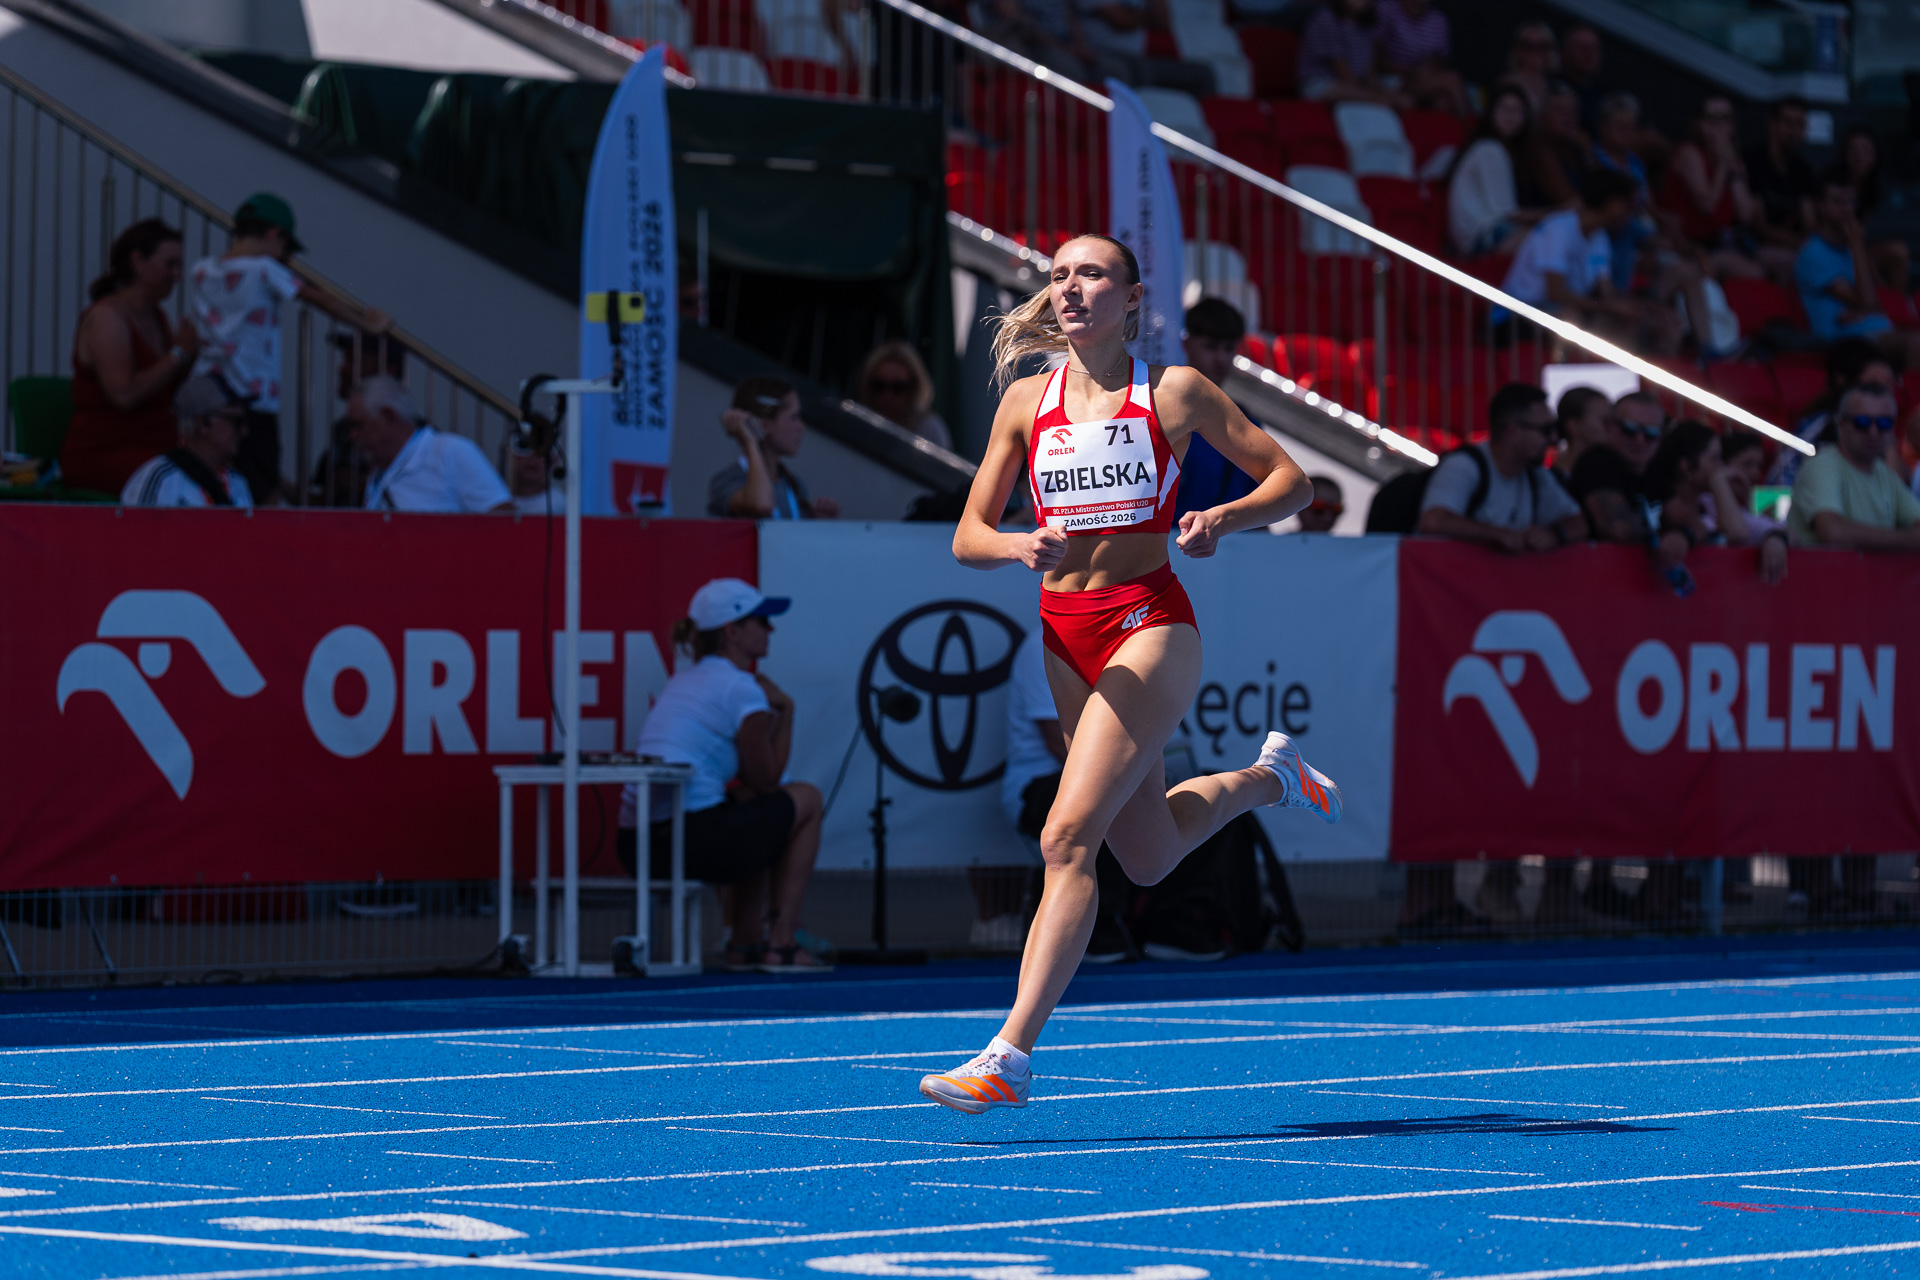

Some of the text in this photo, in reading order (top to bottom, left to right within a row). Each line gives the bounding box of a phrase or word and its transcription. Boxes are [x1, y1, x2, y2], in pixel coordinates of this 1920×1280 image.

[1104, 424, 1135, 446] 71
[1047, 446, 1075, 456] ORLEN
[1040, 461, 1152, 494] ZBIELSKA
[1061, 506, 1076, 515] PZLA
[1075, 503, 1115, 513] Mistrzostwa
[1115, 500, 1136, 509] Polski
[1136, 499, 1149, 507] U20
[1064, 512, 1137, 527] ZAMOŚĆ 2026
[1121, 605, 1149, 630] 4F
[1616, 639, 1897, 754] ORLEN
[1180, 660, 1311, 757] ęcie
